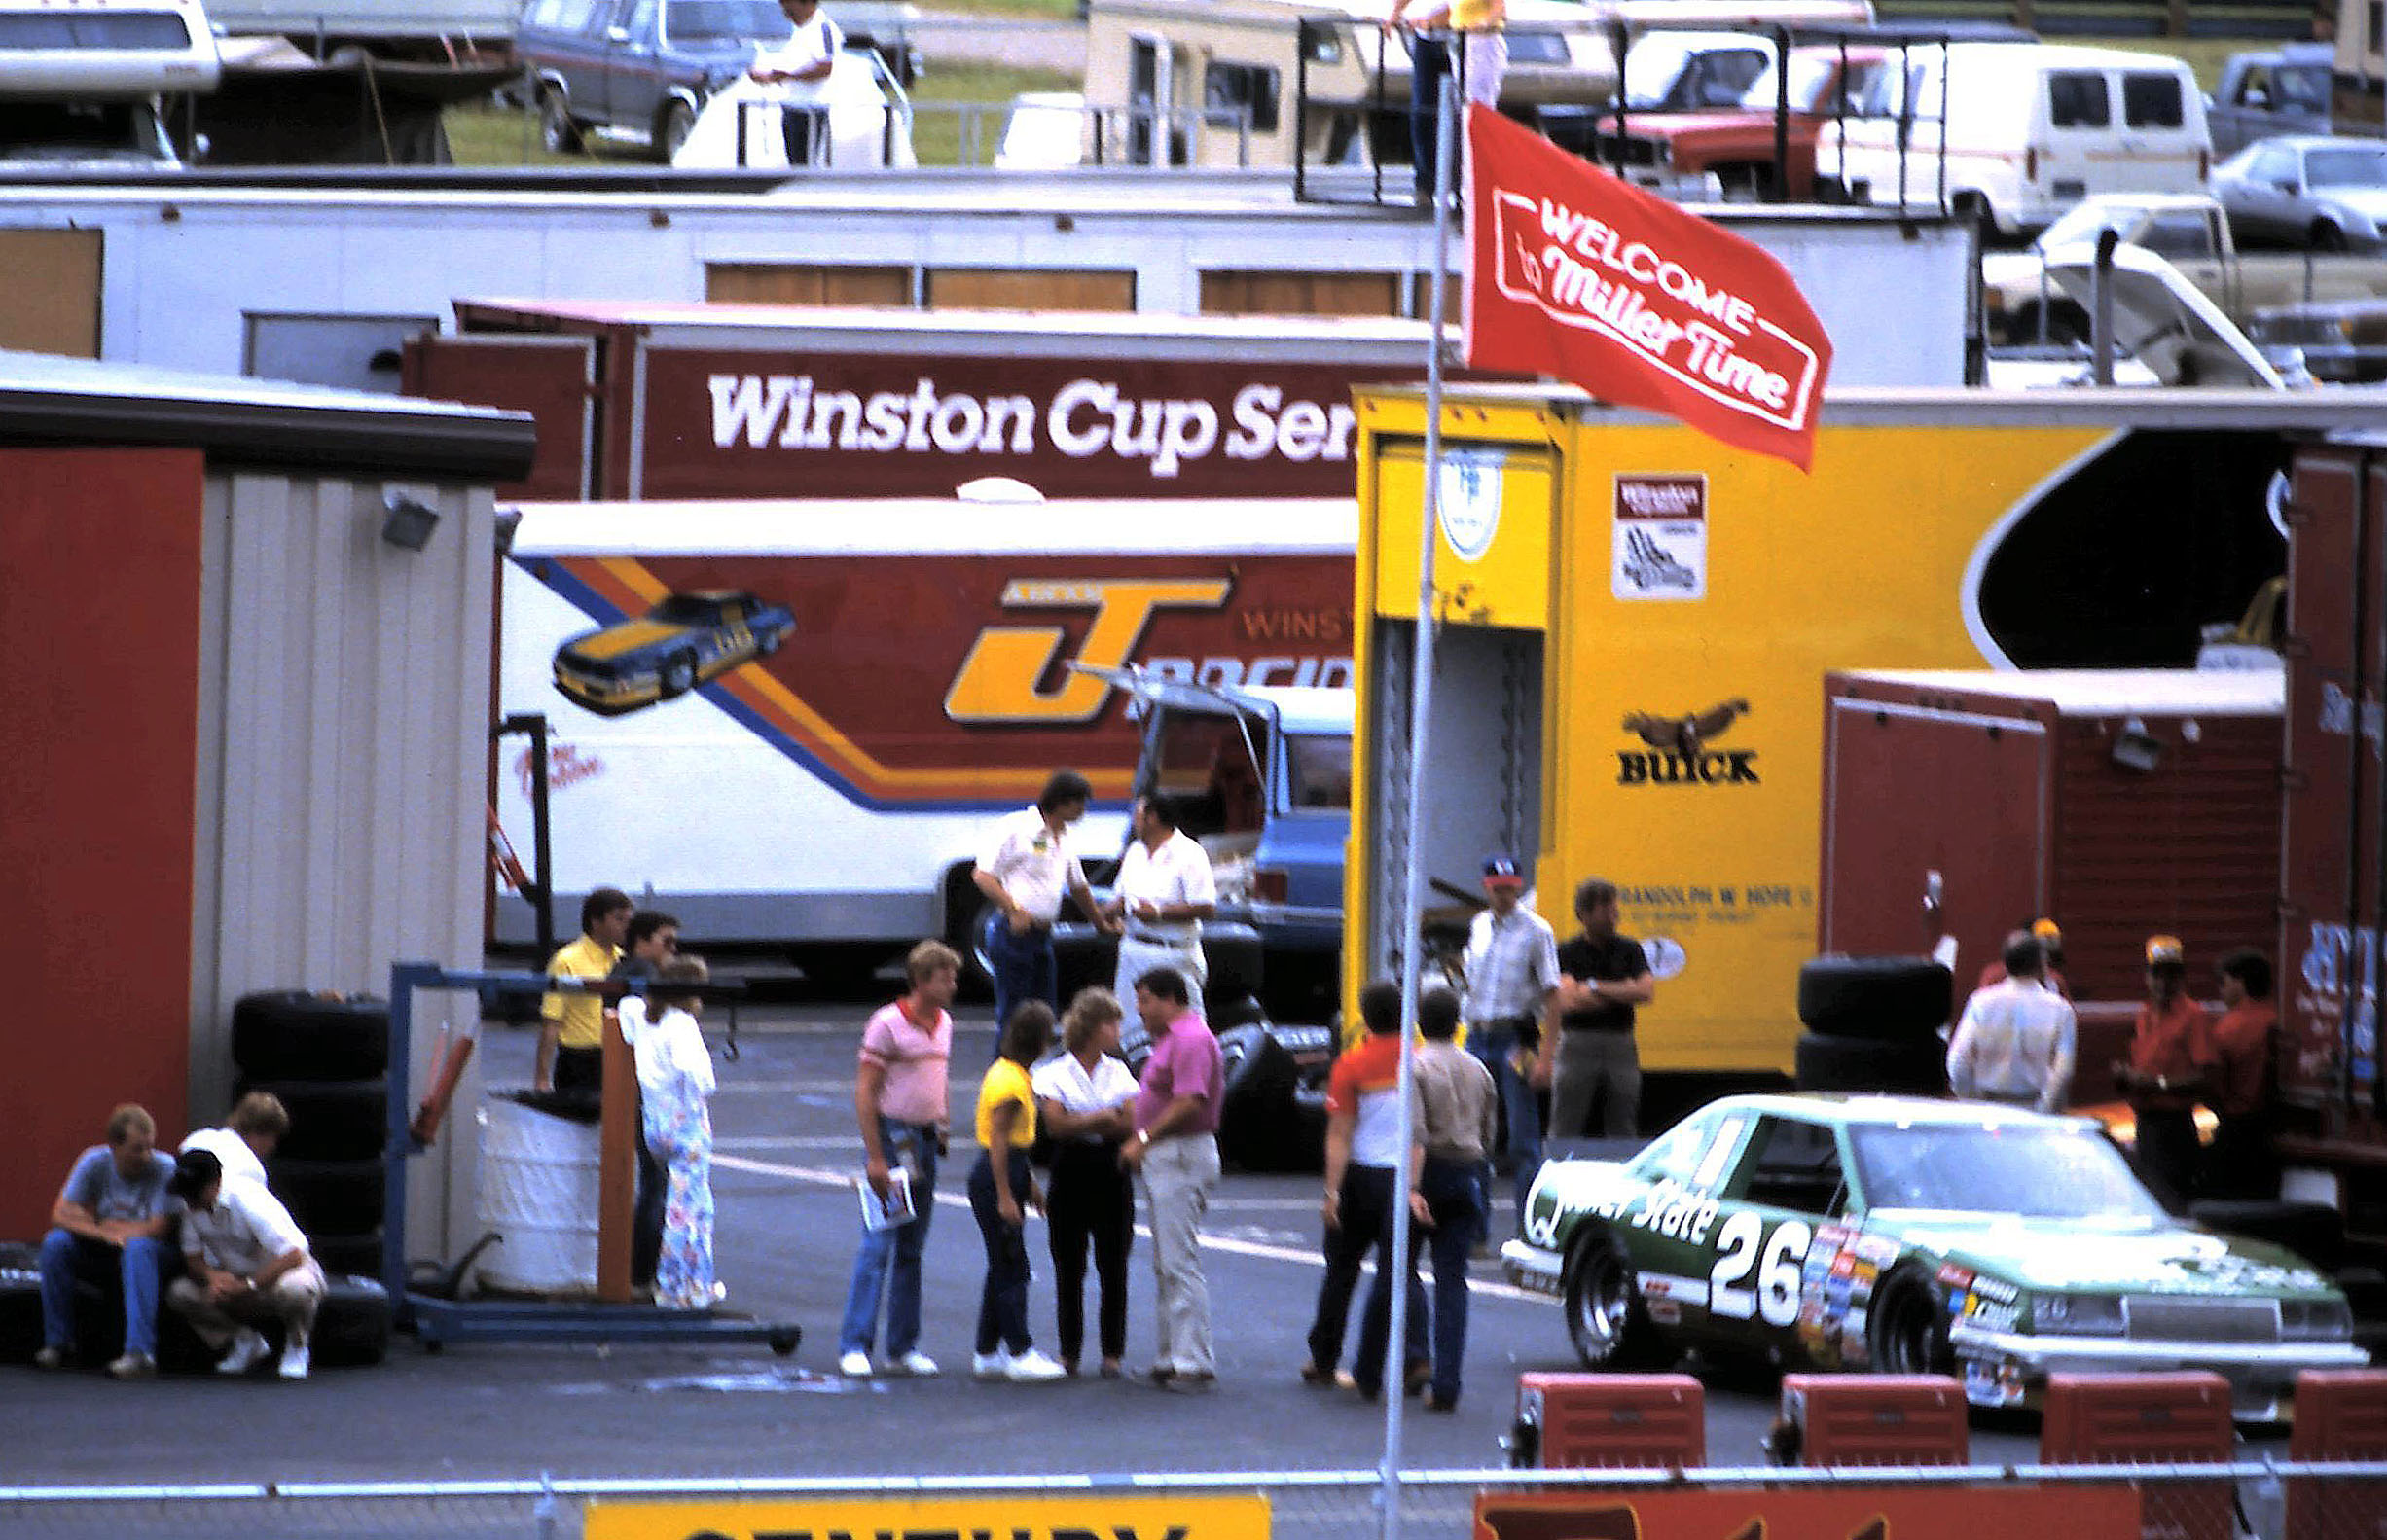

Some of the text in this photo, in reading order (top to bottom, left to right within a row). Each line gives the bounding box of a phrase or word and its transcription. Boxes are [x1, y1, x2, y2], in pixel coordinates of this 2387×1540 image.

[1541, 197, 1756, 337] WELCOME
[1542, 244, 1684, 356] Miller
[1684, 319, 1790, 409] Time
[708, 375, 1358, 478] Winston Cup Ser
[1241, 610, 1353, 640] WINS
[1618, 751, 1760, 784] BUICK
[1631, 1178, 1720, 1246] State
[1710, 1211, 1812, 1328] 26
